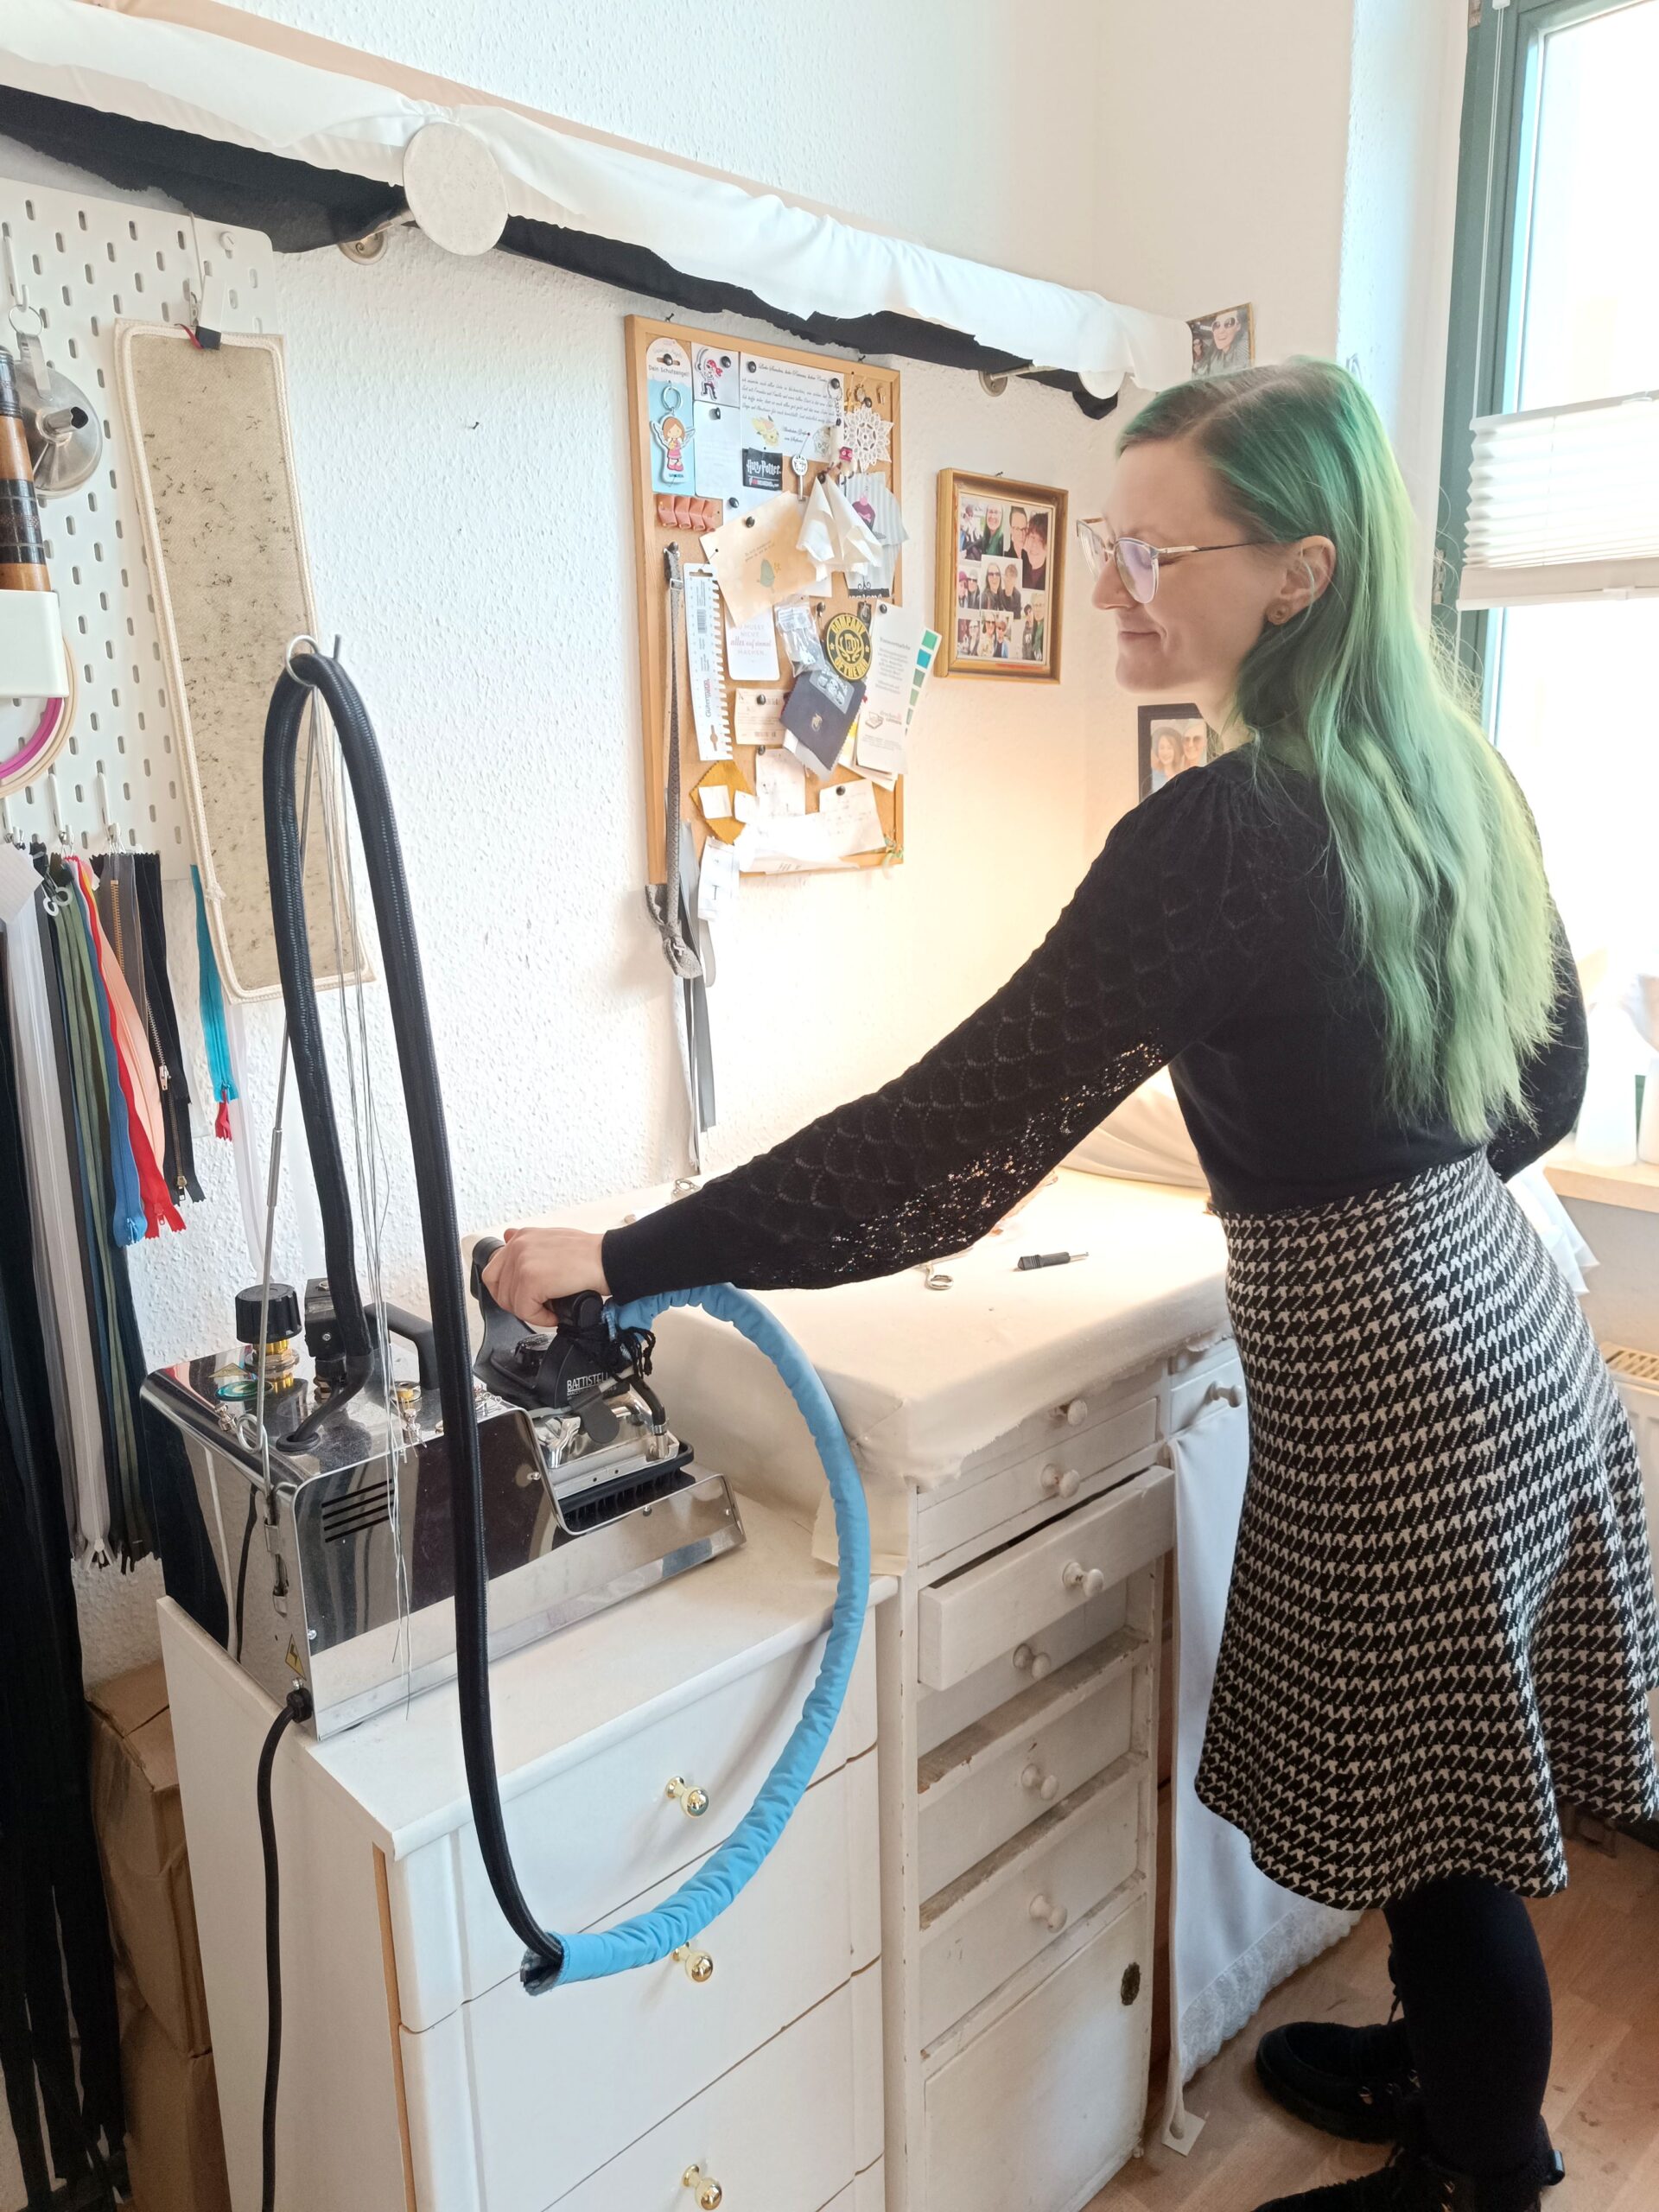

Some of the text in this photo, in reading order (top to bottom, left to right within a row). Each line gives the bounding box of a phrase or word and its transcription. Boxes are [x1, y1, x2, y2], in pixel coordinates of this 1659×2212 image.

[746, 459, 781, 477] Harry Potter
[830, 614, 866, 634] COMPANY
